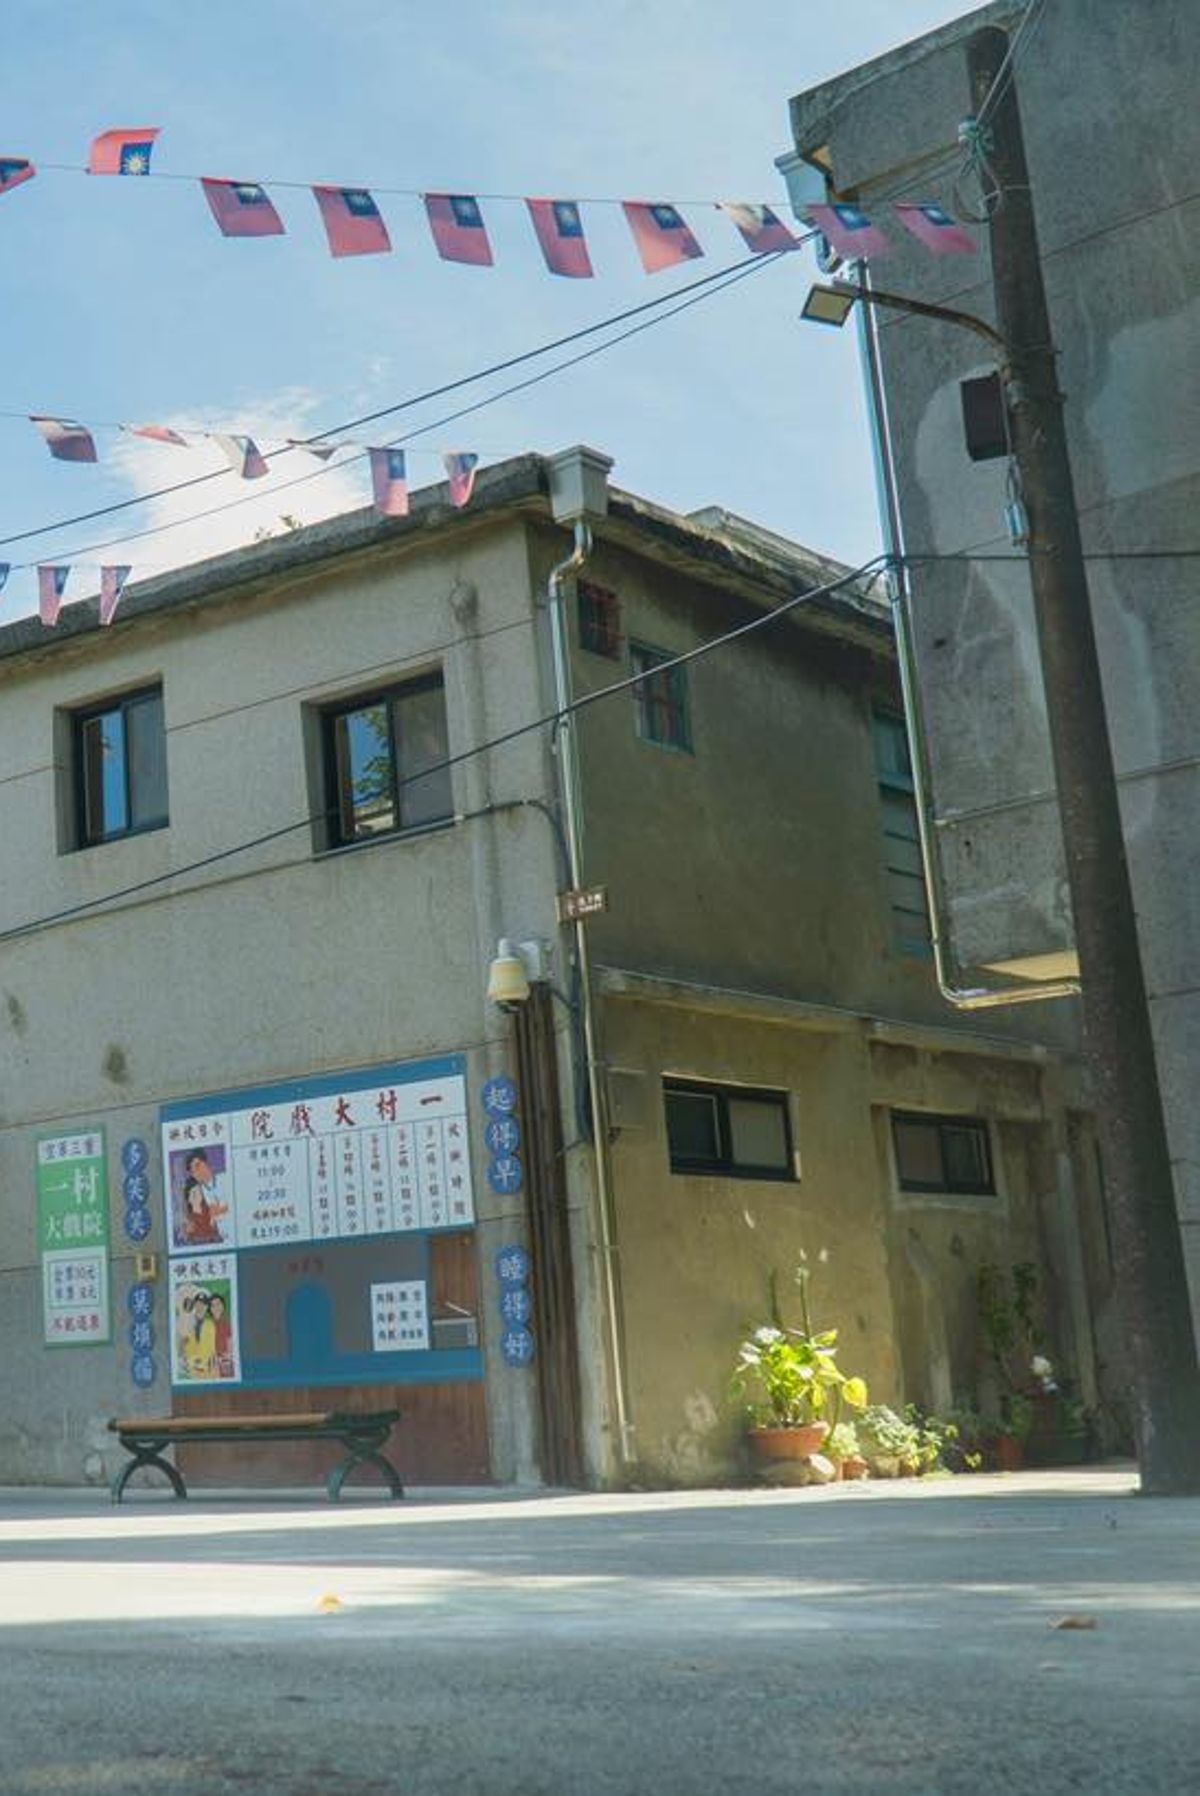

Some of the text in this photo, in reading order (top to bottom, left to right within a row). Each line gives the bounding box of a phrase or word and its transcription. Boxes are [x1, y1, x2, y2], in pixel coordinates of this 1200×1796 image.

[45, 1166, 100, 1204] 一村
[487, 1087, 516, 1187] 起得早
[500, 1256, 529, 1356] 睡得好
